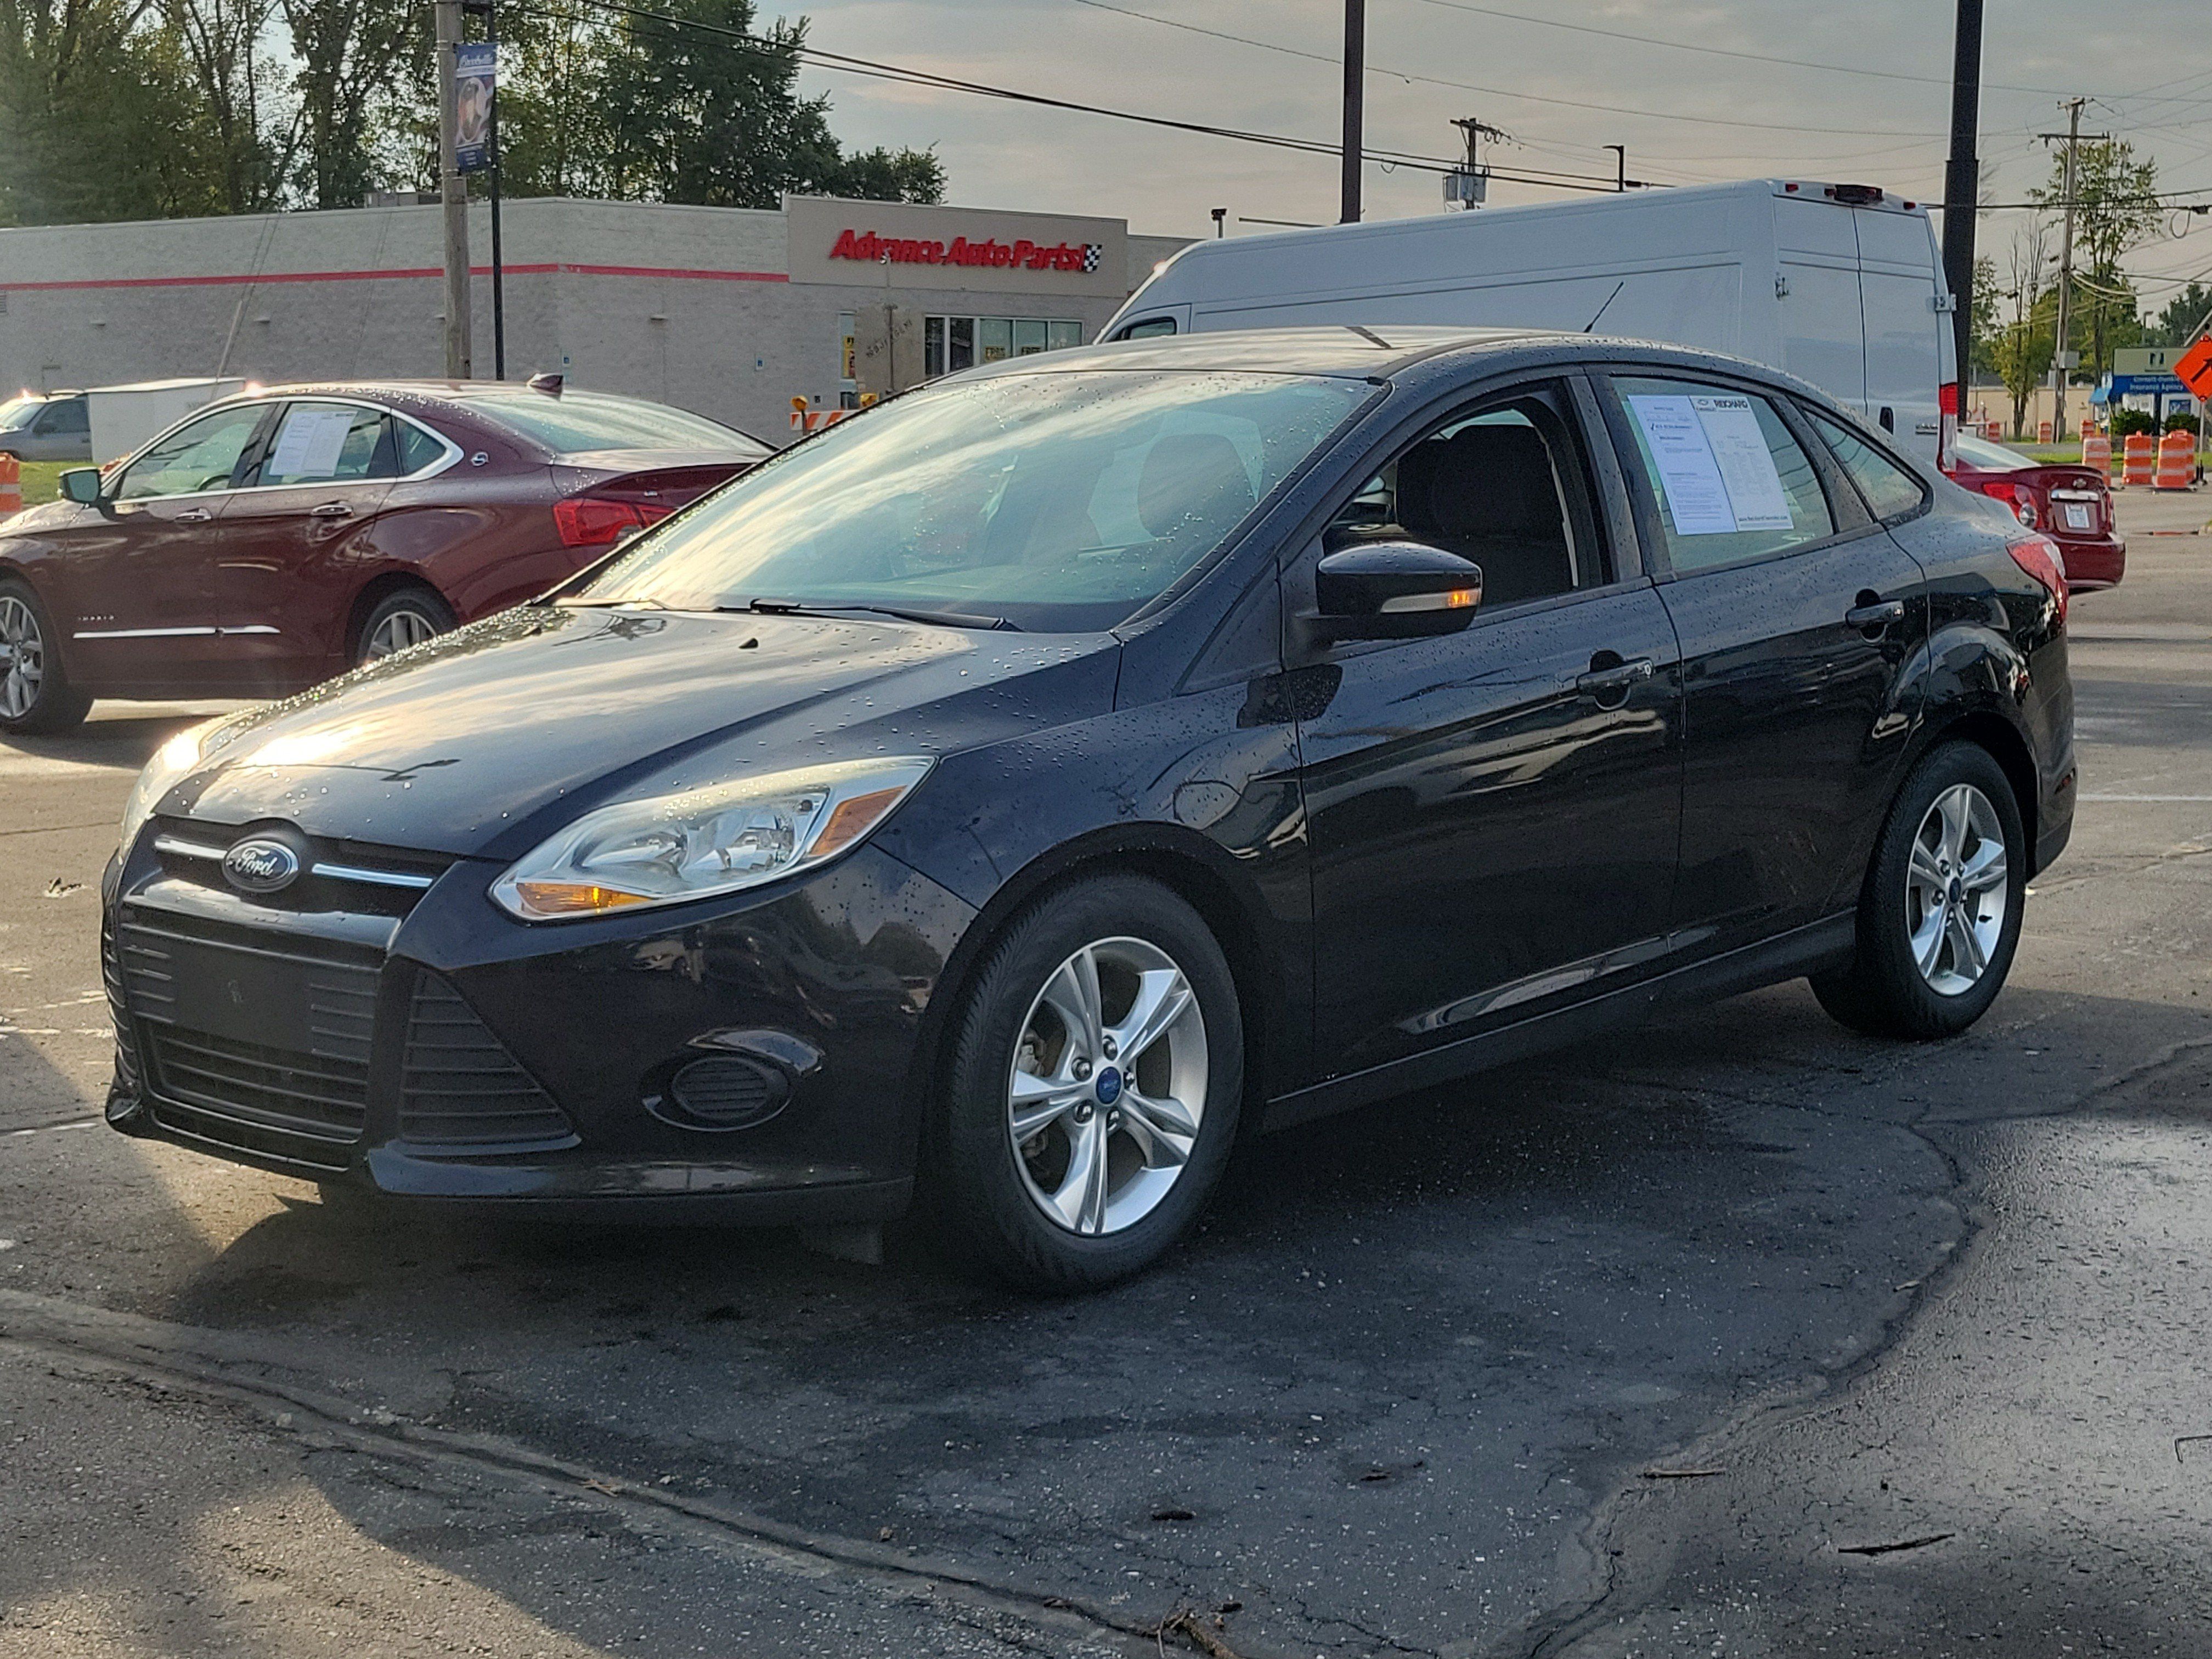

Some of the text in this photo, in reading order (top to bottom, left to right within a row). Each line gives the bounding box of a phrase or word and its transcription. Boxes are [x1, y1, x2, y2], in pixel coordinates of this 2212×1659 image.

[829, 229, 1081, 271] Advance Auto Parts
[235, 847, 278, 876] Ford
